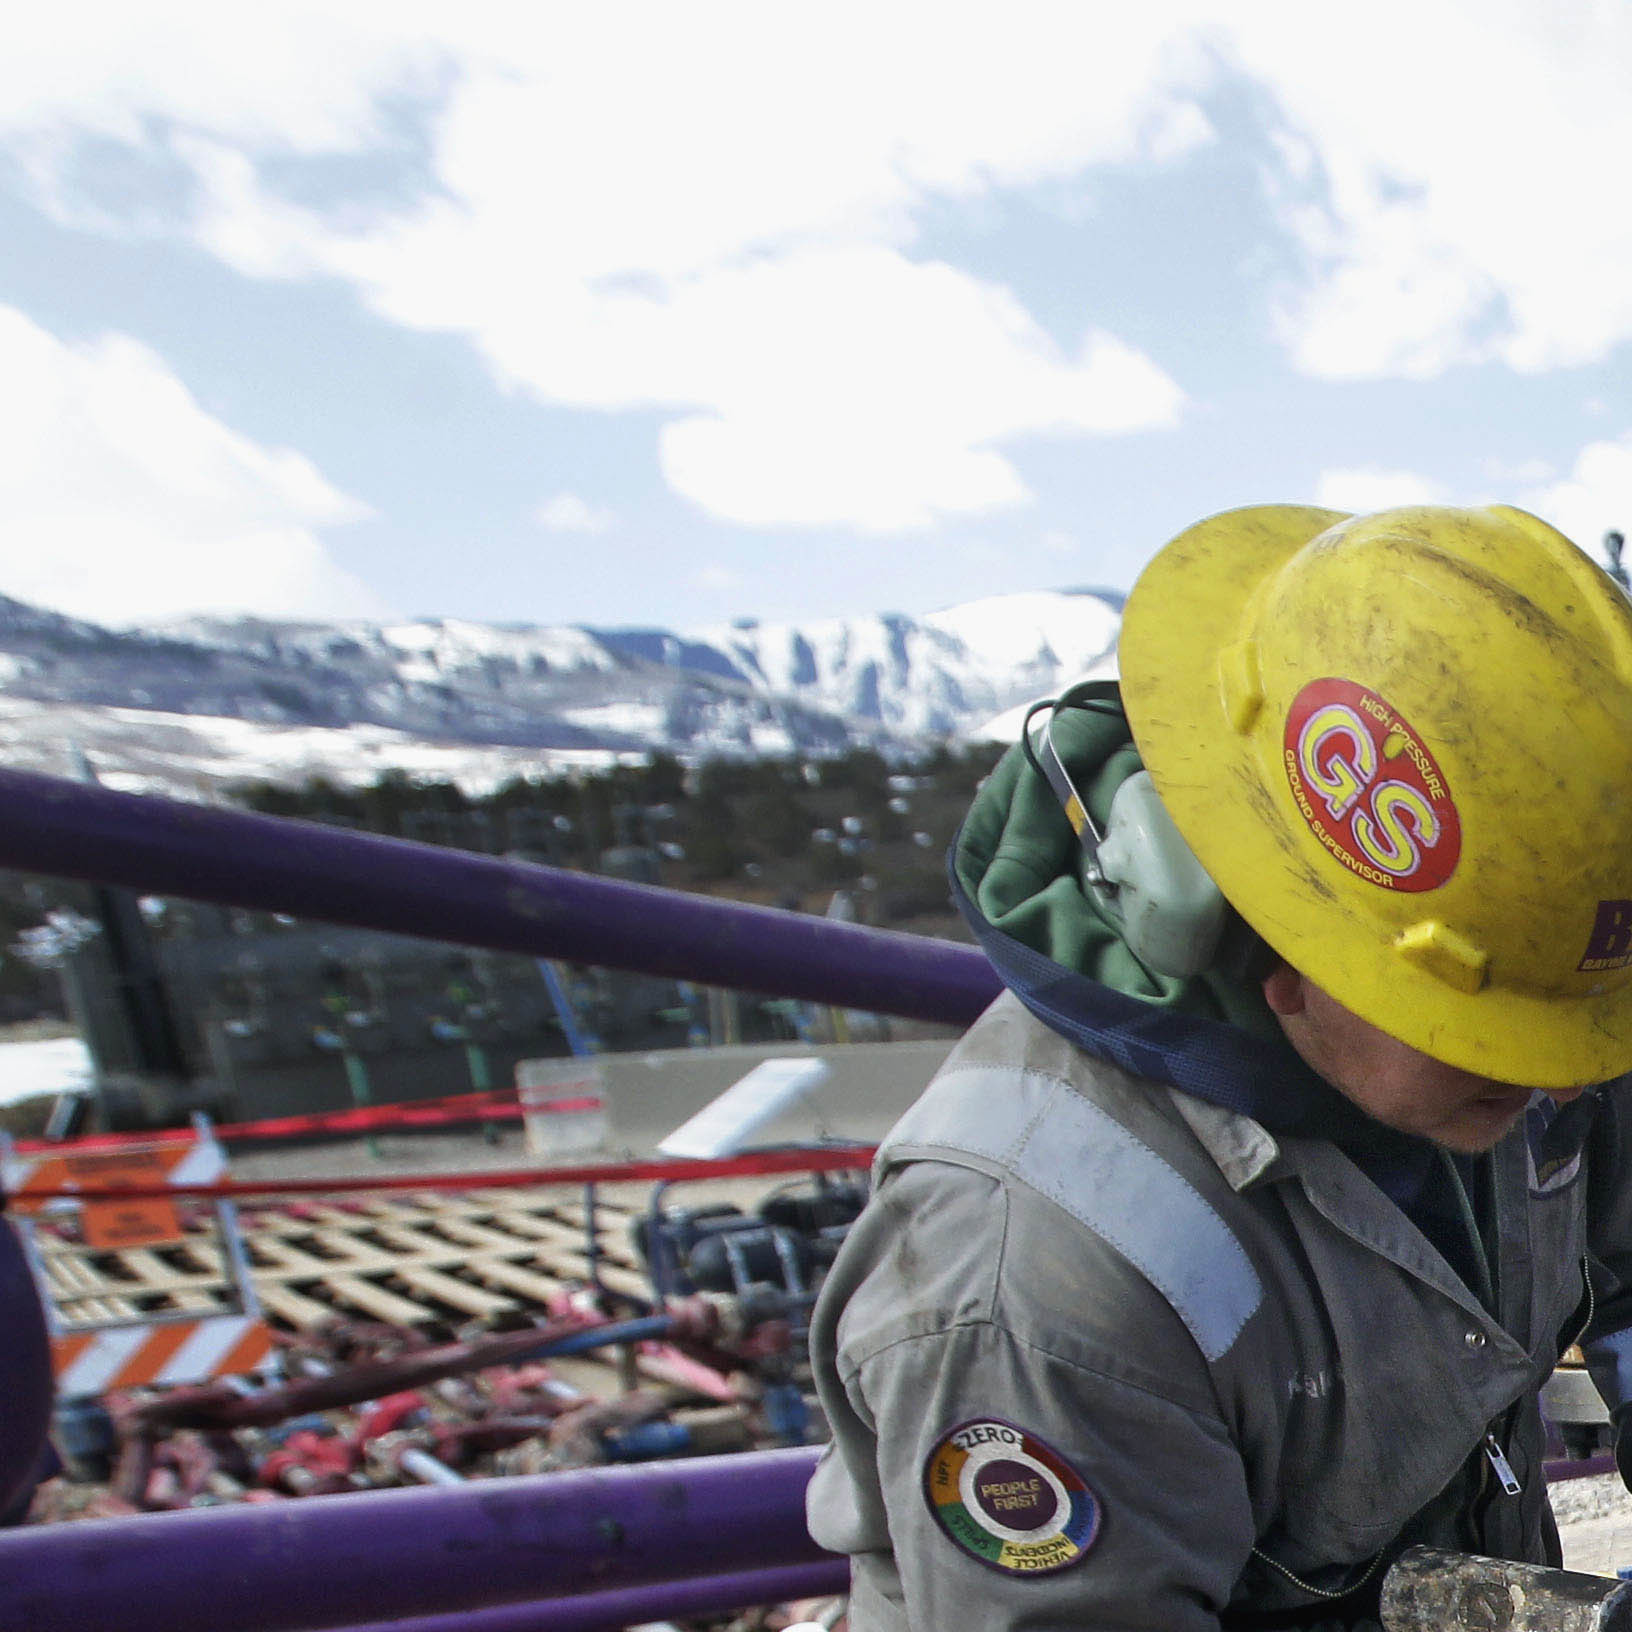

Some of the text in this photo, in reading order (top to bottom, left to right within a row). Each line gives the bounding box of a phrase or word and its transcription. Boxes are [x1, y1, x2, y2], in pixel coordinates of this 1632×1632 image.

[1360, 694, 1394, 728] HIGH
[1298, 703, 1442, 878] GS
[1285, 749, 1394, 887] GROUND SUPERVISOR
[957, 1427, 1016, 1449] ZERO
[981, 1478, 1042, 1498] PEOPLE
[993, 1493, 1039, 1512] FIRST
[1005, 1537, 1071, 1558] INCIDENTS
[1013, 1552, 1072, 1569] VEHICLE
